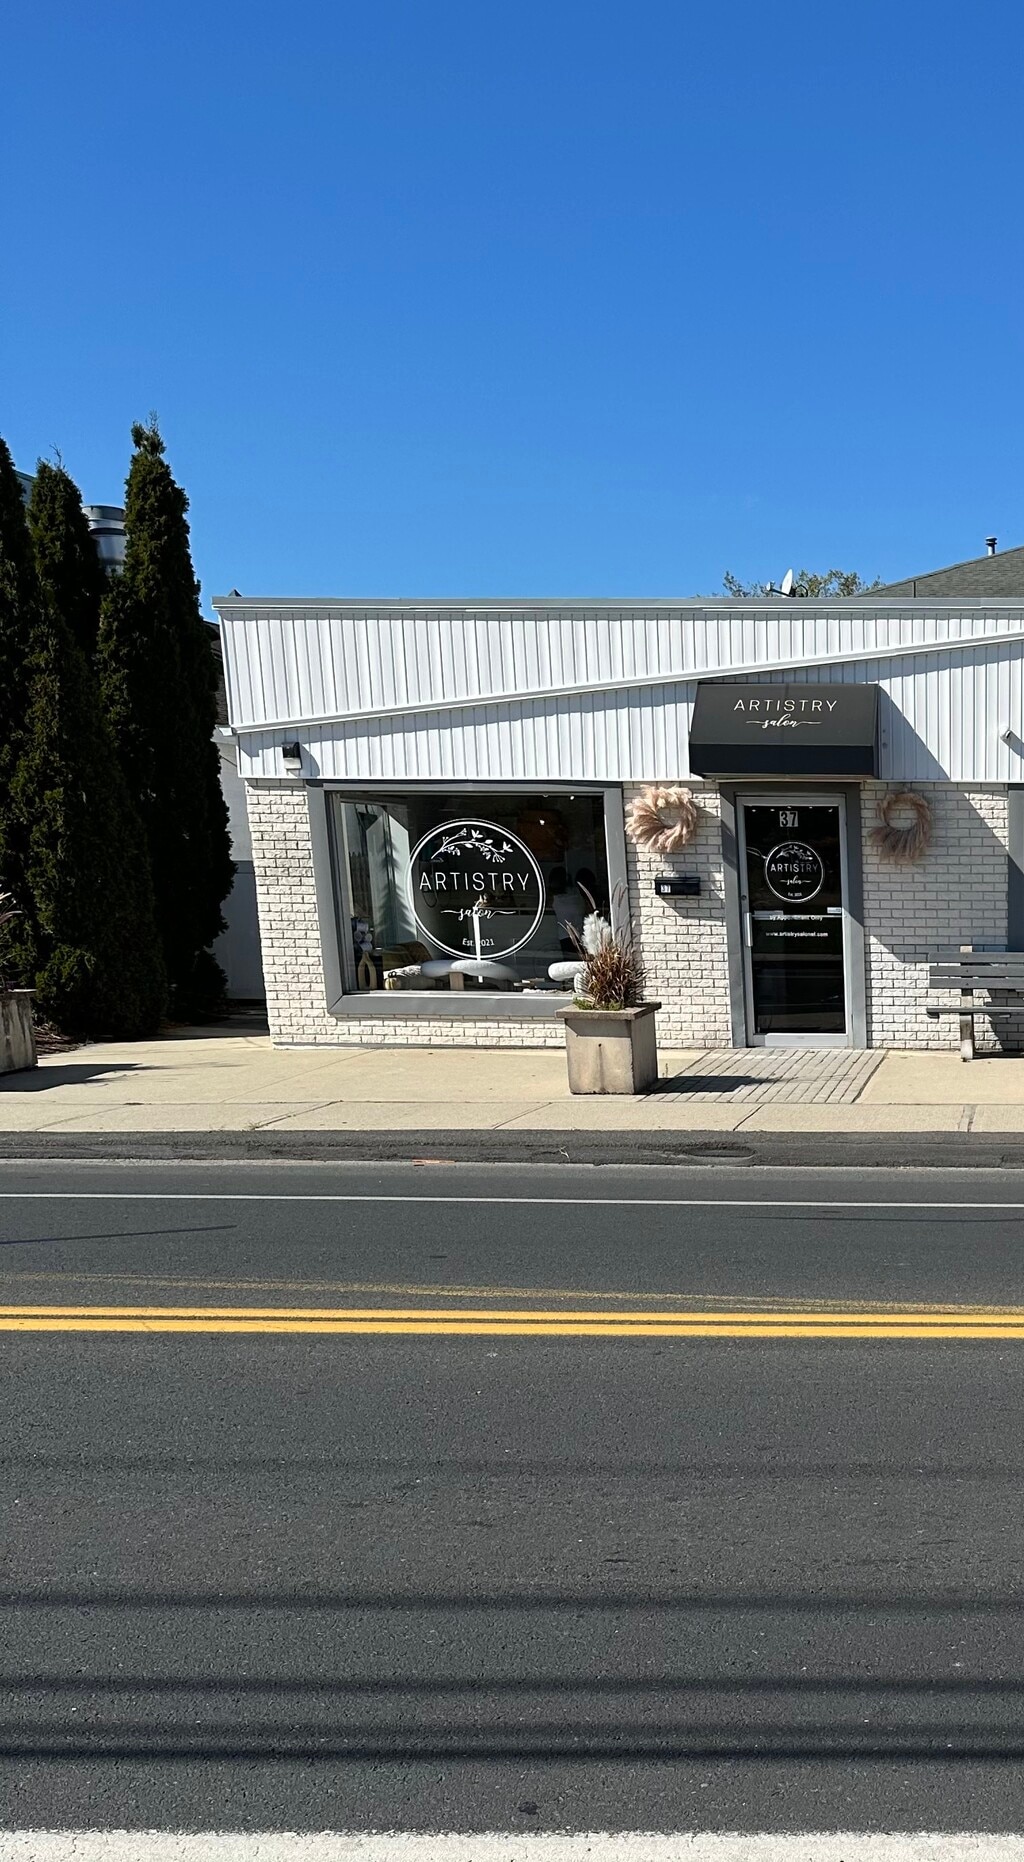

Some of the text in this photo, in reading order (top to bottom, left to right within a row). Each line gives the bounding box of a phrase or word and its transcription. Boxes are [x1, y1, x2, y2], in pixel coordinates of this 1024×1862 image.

[733, 699, 838, 712] ARTISTRY
[780, 811, 797, 827] 37
[770, 863, 819, 873] ARTISTRY
[420, 871, 530, 892] ARTISTRY
